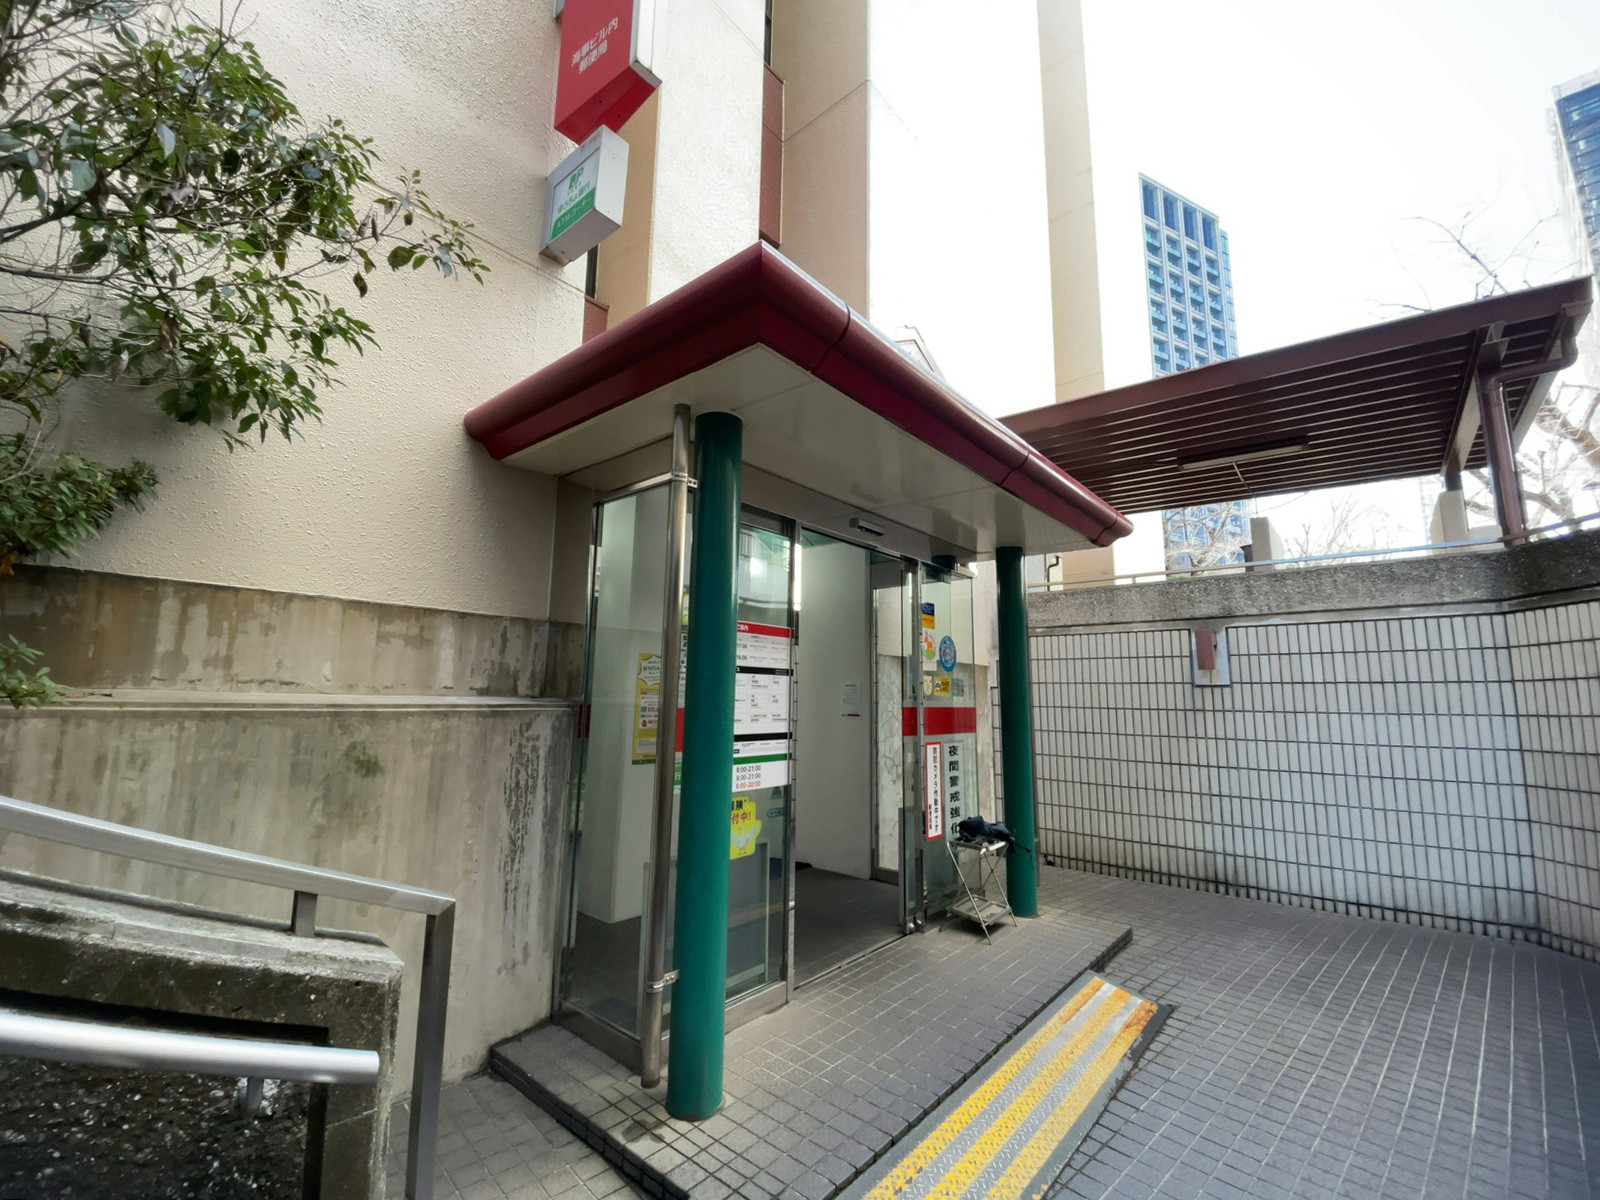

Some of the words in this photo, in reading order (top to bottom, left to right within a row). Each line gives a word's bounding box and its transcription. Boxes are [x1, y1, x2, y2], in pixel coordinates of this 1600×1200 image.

[579, 40, 608, 74] 郵便局
[556, 196, 593, 229] ATMコーナー
[557, 180, 591, 213] ゆうちょ銀行
[736, 764, 762, 774] 8:00-21:00
[736, 772, 761, 782] 8:00-21:00
